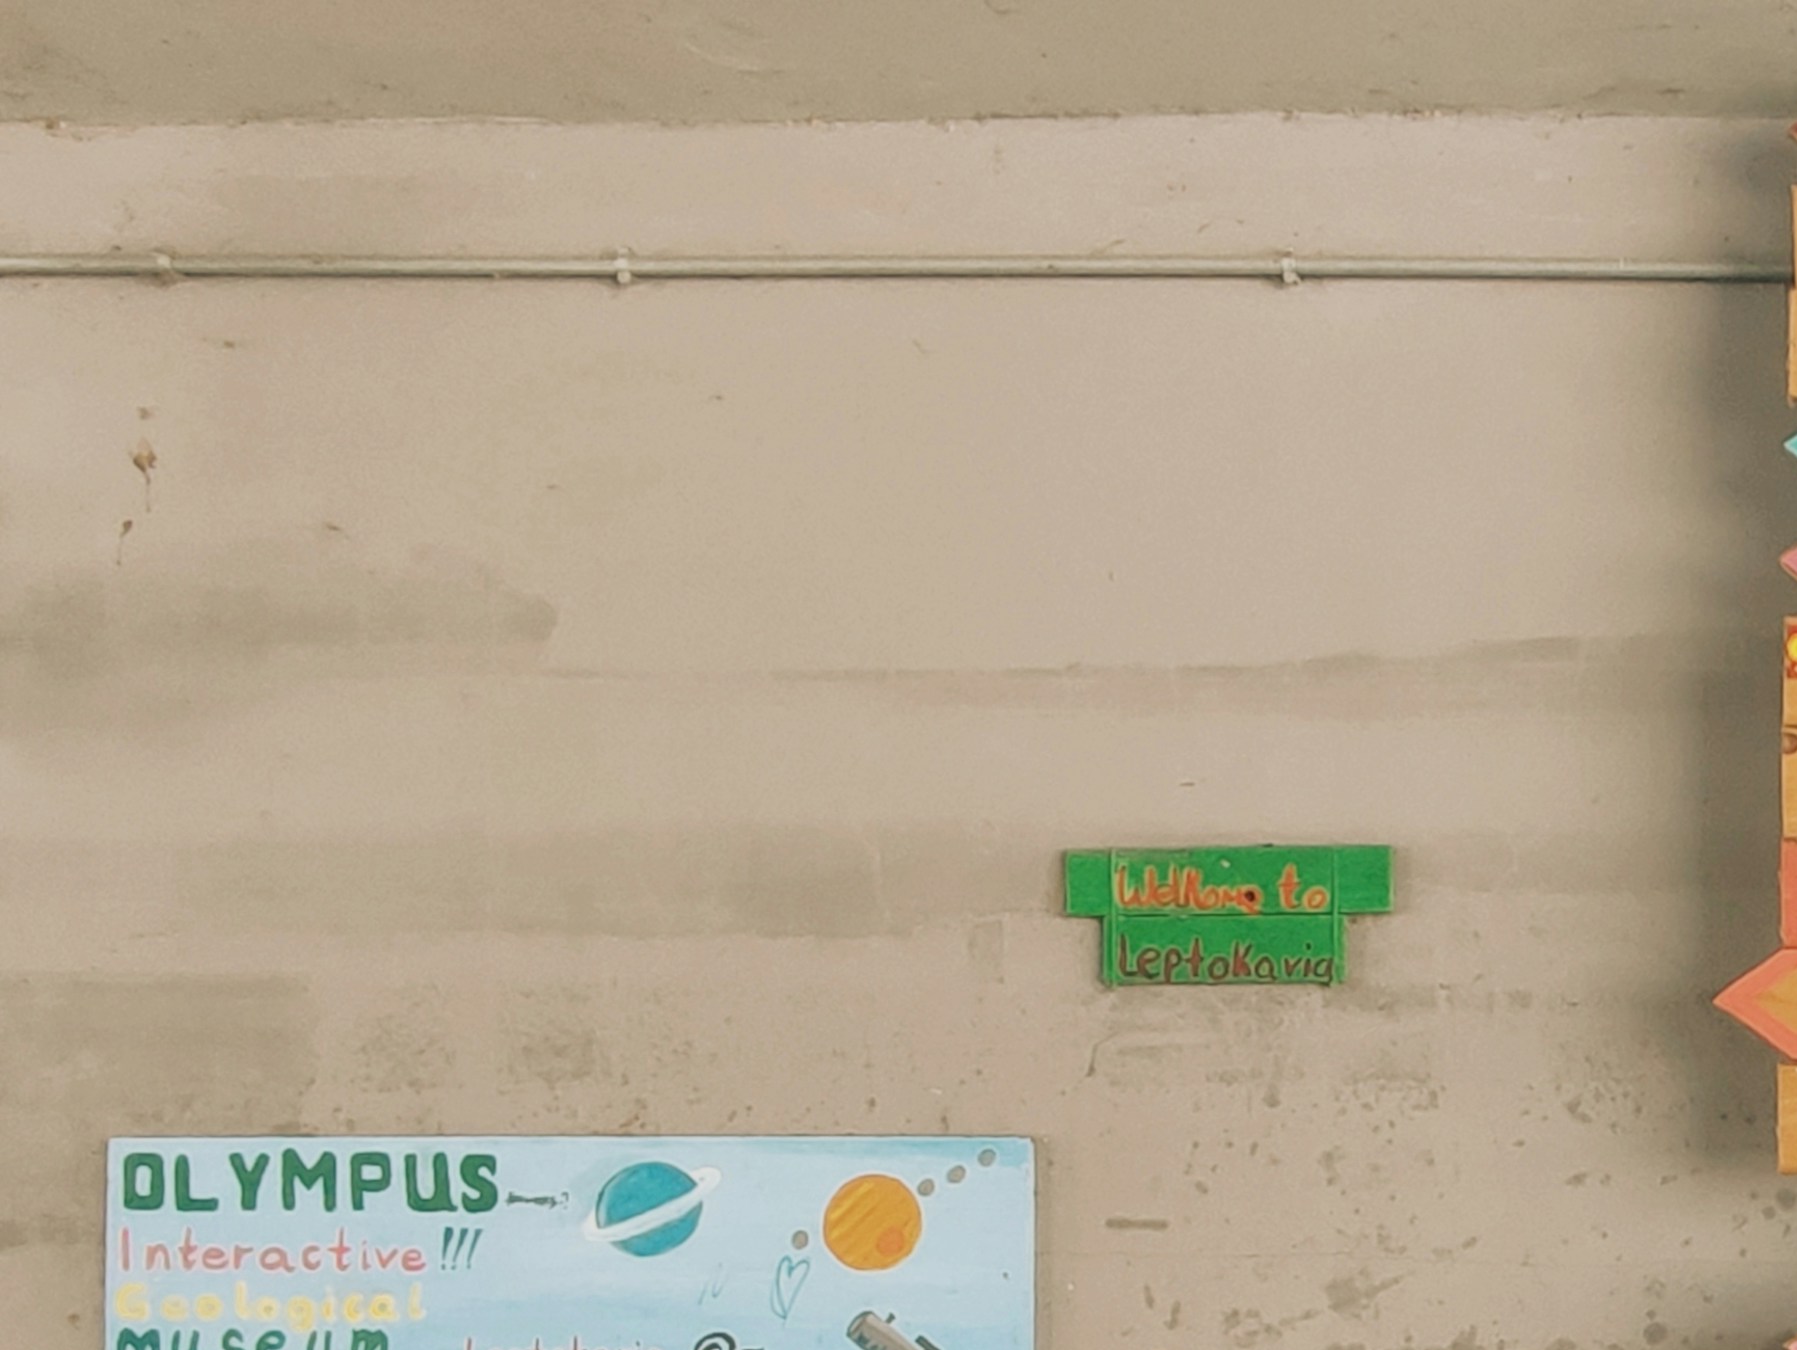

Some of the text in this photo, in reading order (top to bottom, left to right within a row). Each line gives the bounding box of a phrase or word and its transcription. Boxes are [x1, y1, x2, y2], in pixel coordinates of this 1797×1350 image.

[1277, 864, 1330, 909] to
[121, 1148, 499, 1213] OLYMPUS
[119, 1226, 427, 1273] Interactive
[114, 1281, 426, 1332] Geological
